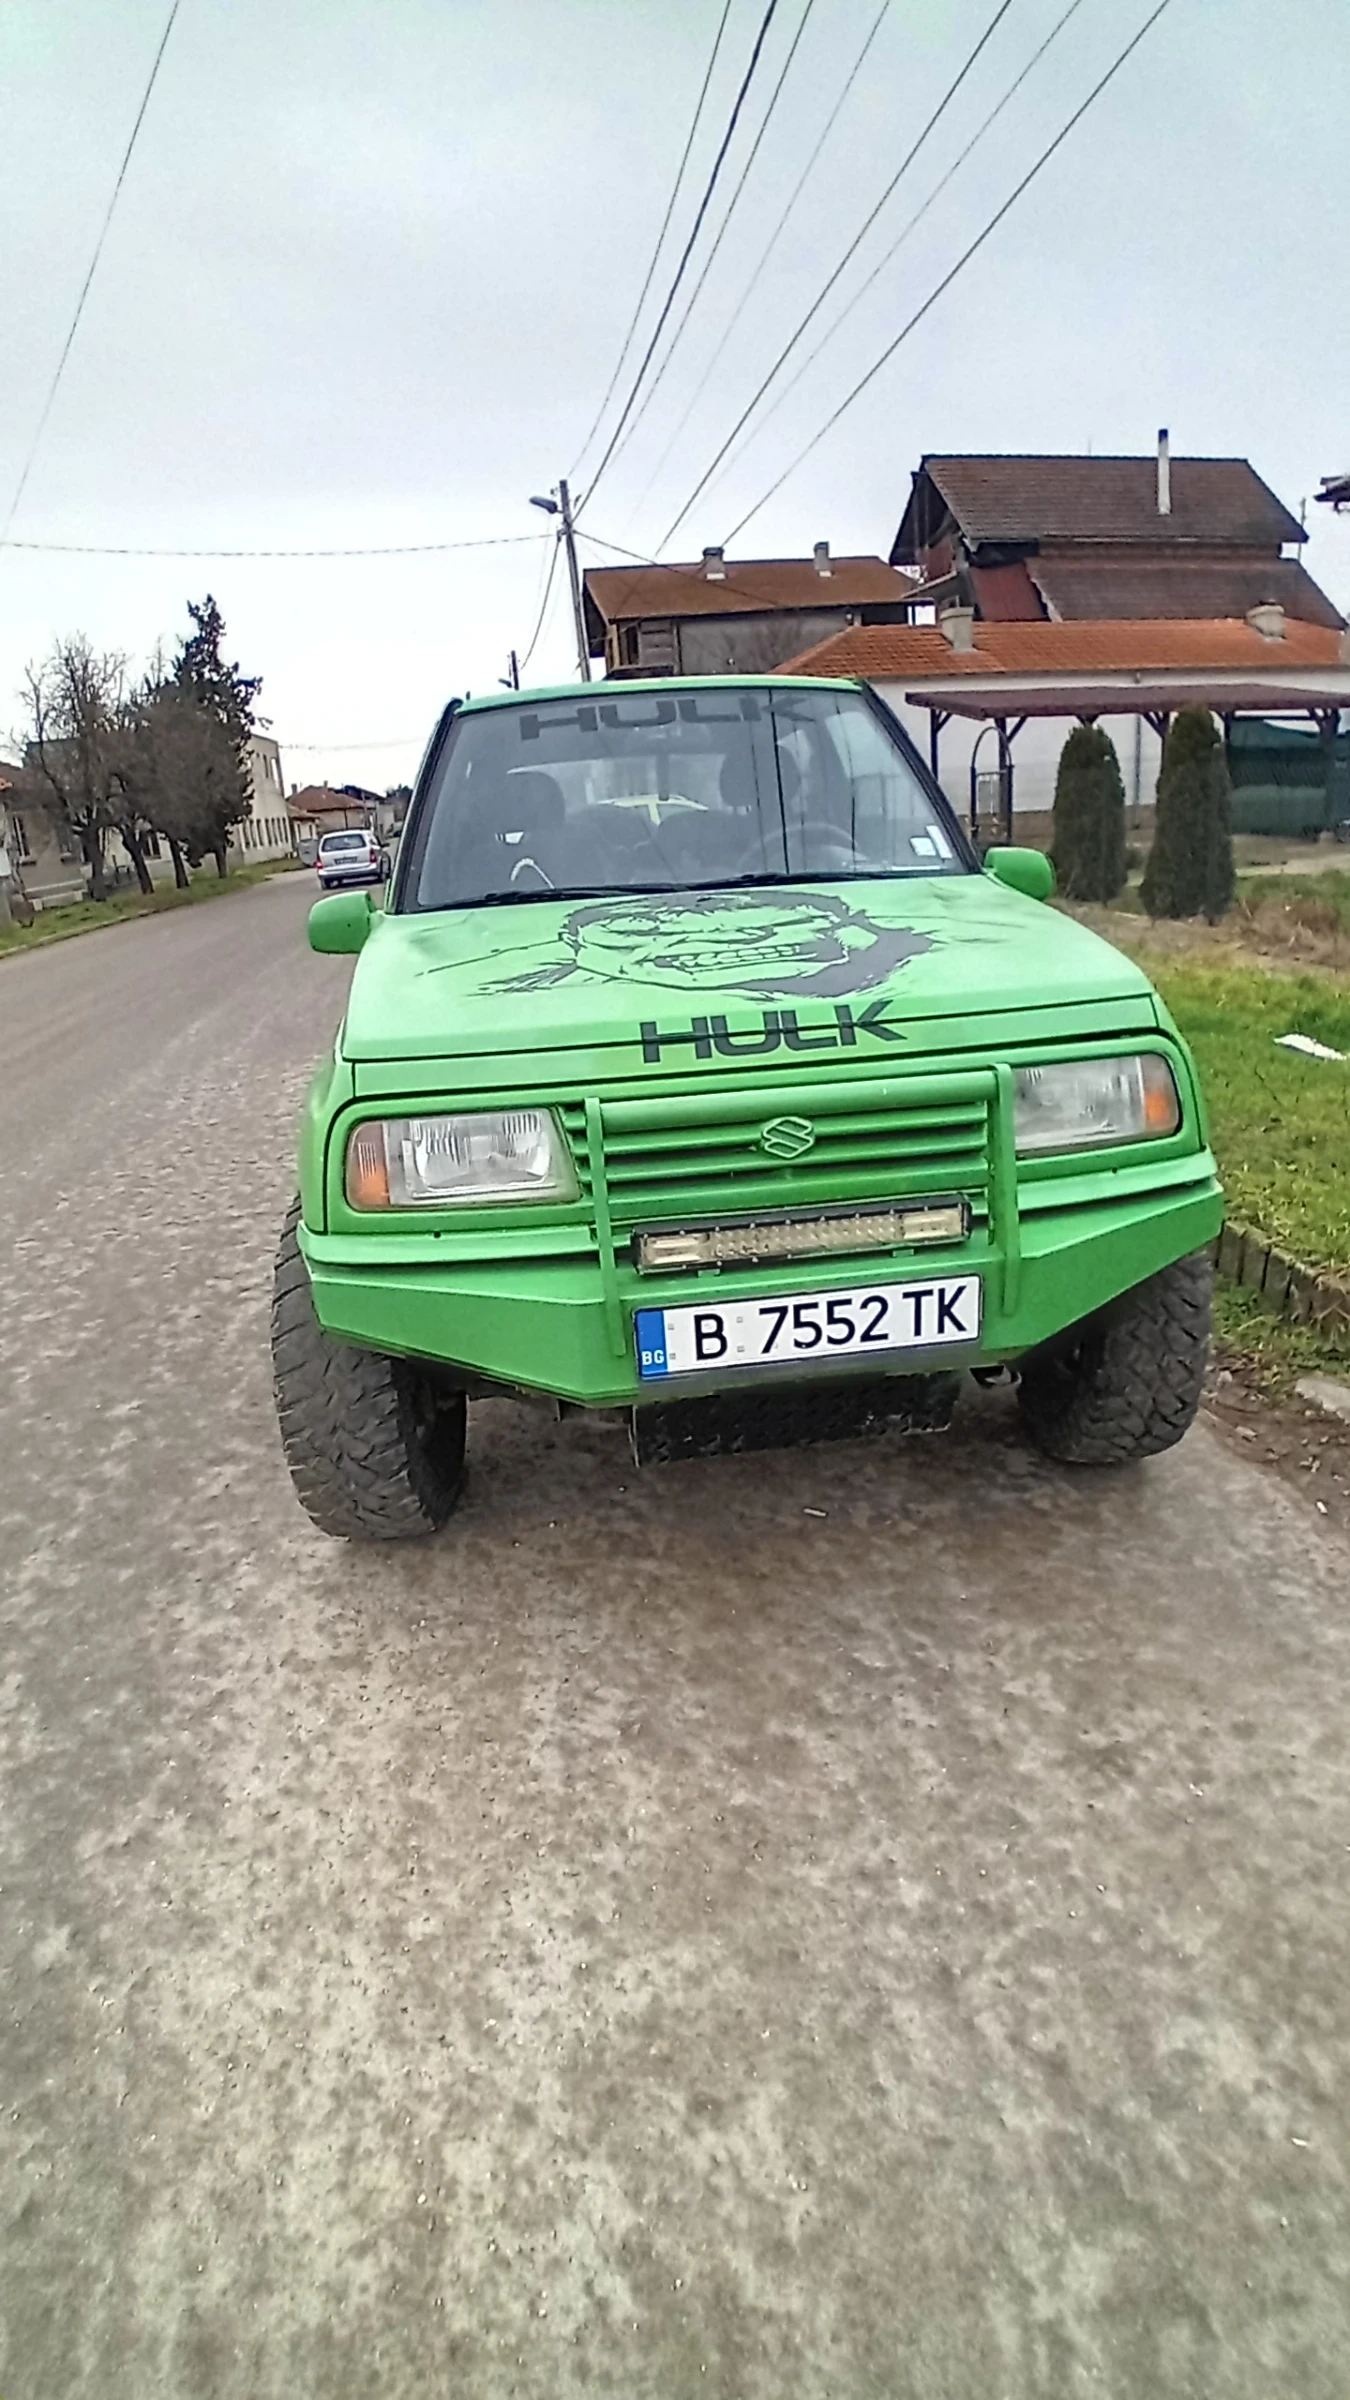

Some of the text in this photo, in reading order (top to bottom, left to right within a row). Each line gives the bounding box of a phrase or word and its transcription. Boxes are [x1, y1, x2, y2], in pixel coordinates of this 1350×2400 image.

[519, 696, 816, 740] HULK
[639, 999, 908, 1064] HULK
[693, 1285, 968, 1361] B 7552 TK
[641, 1349, 665, 1366] BG
